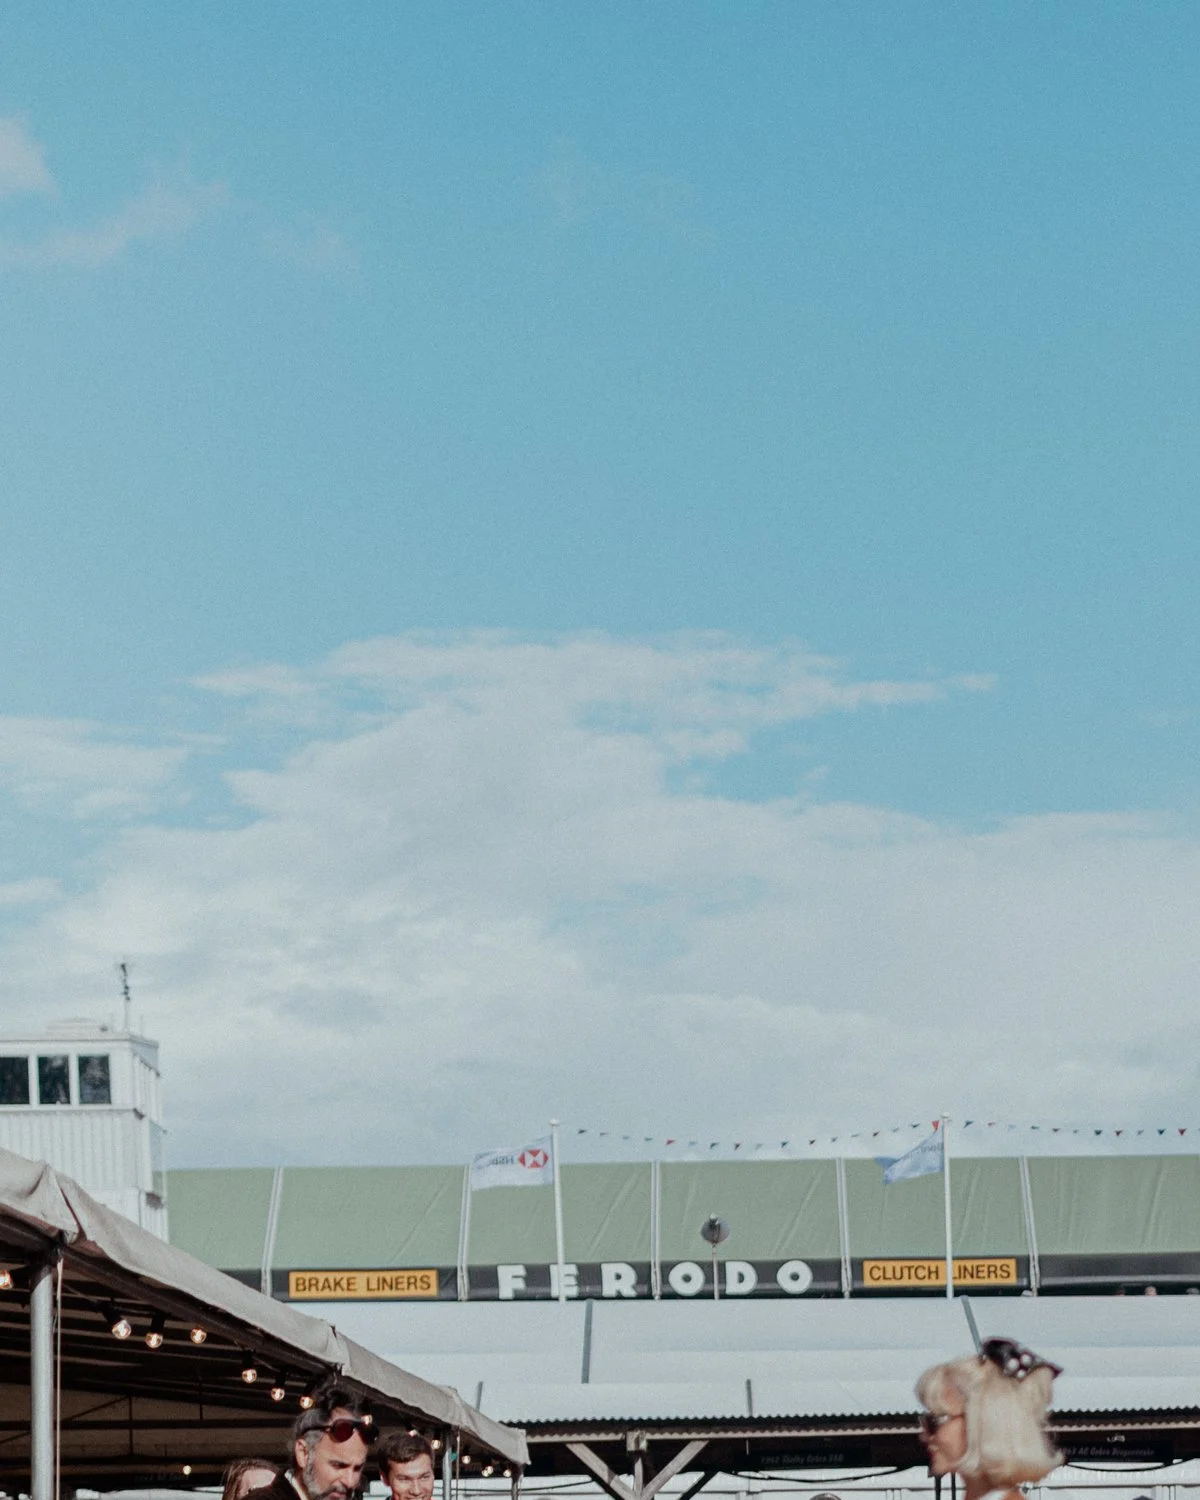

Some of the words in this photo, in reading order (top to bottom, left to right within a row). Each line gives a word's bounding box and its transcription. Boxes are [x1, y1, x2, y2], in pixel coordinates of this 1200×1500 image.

[496, 1259, 814, 1300] FERODO
[868, 1265, 939, 1281] CLUTCH
[295, 1277, 357, 1293] BRAKE
[366, 1275, 431, 1292] LINERS
